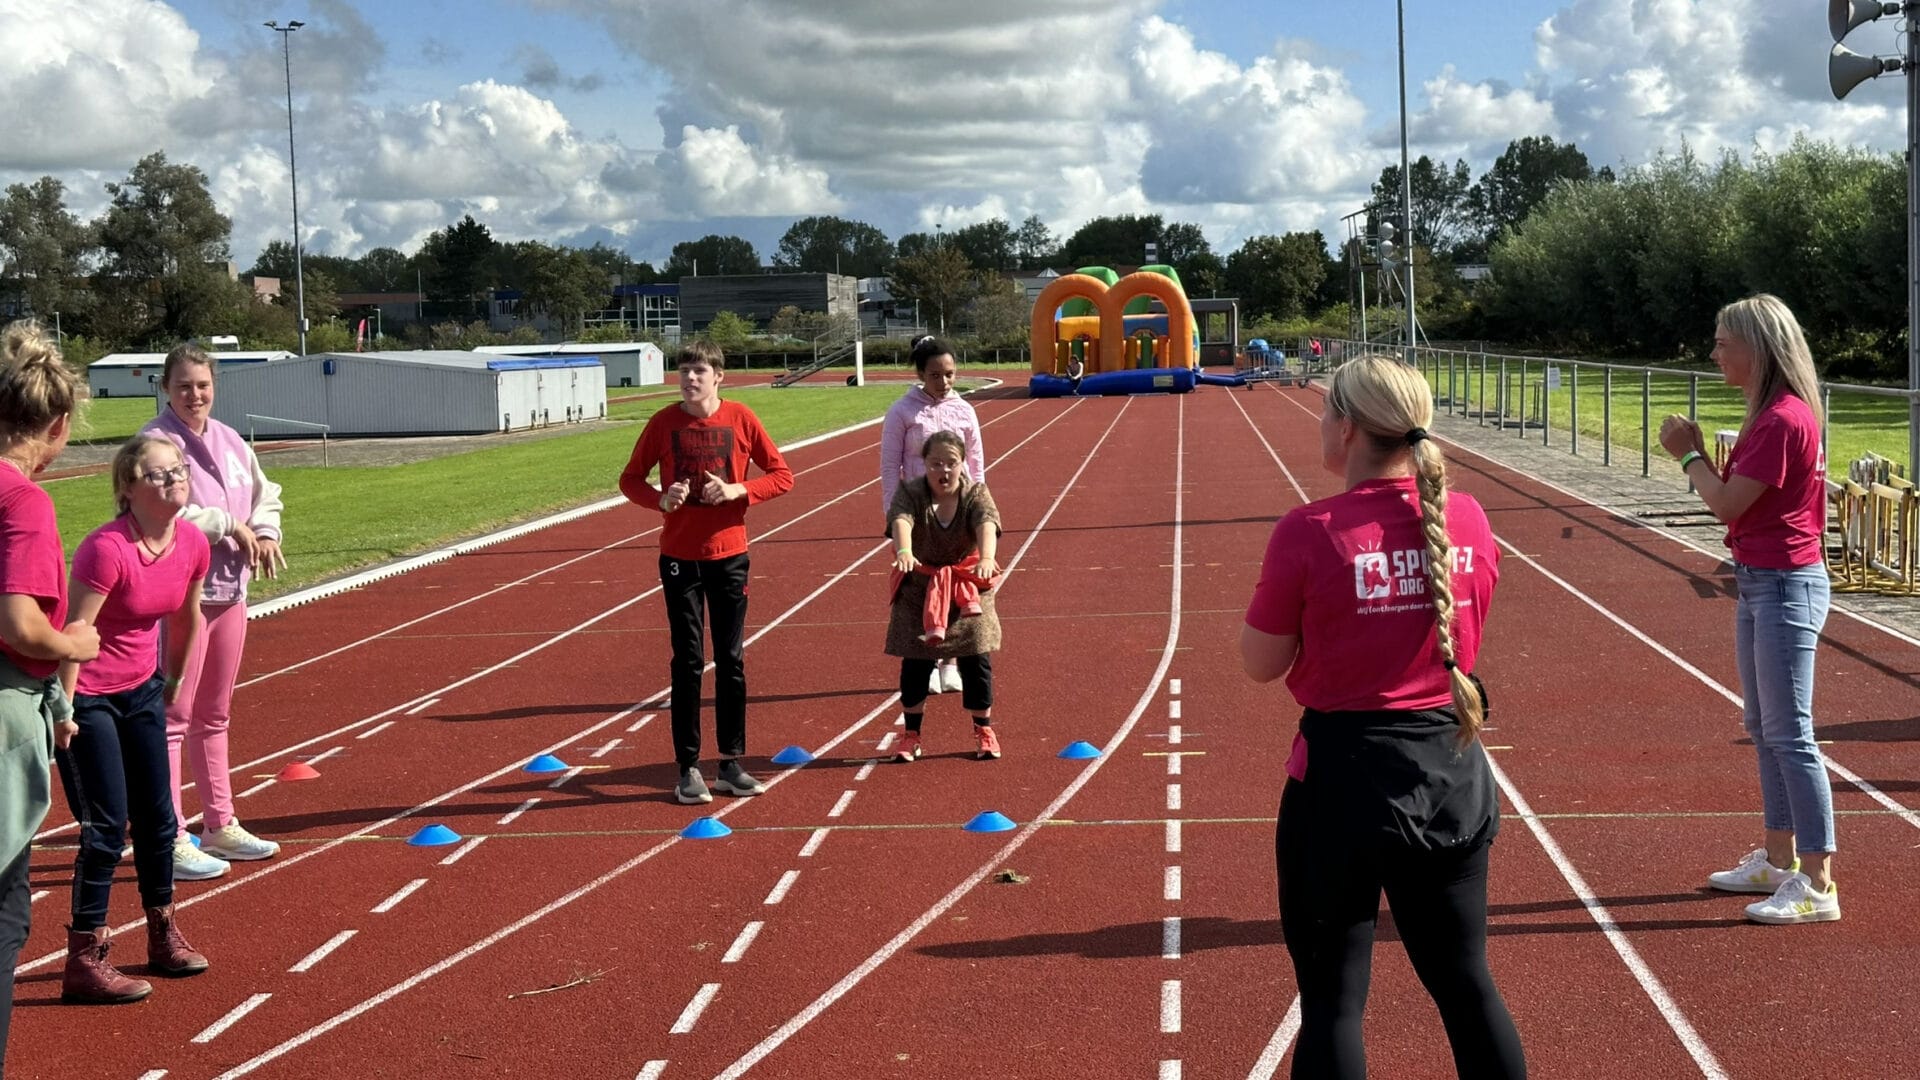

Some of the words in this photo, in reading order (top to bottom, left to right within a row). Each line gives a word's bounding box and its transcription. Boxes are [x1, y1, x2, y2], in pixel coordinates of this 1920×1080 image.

[224, 450, 253, 489] A
[670, 561, 680, 576] 3
[1392, 546, 1474, 577] SPOT-Z
[1396, 578, 1425, 596] .ORG
